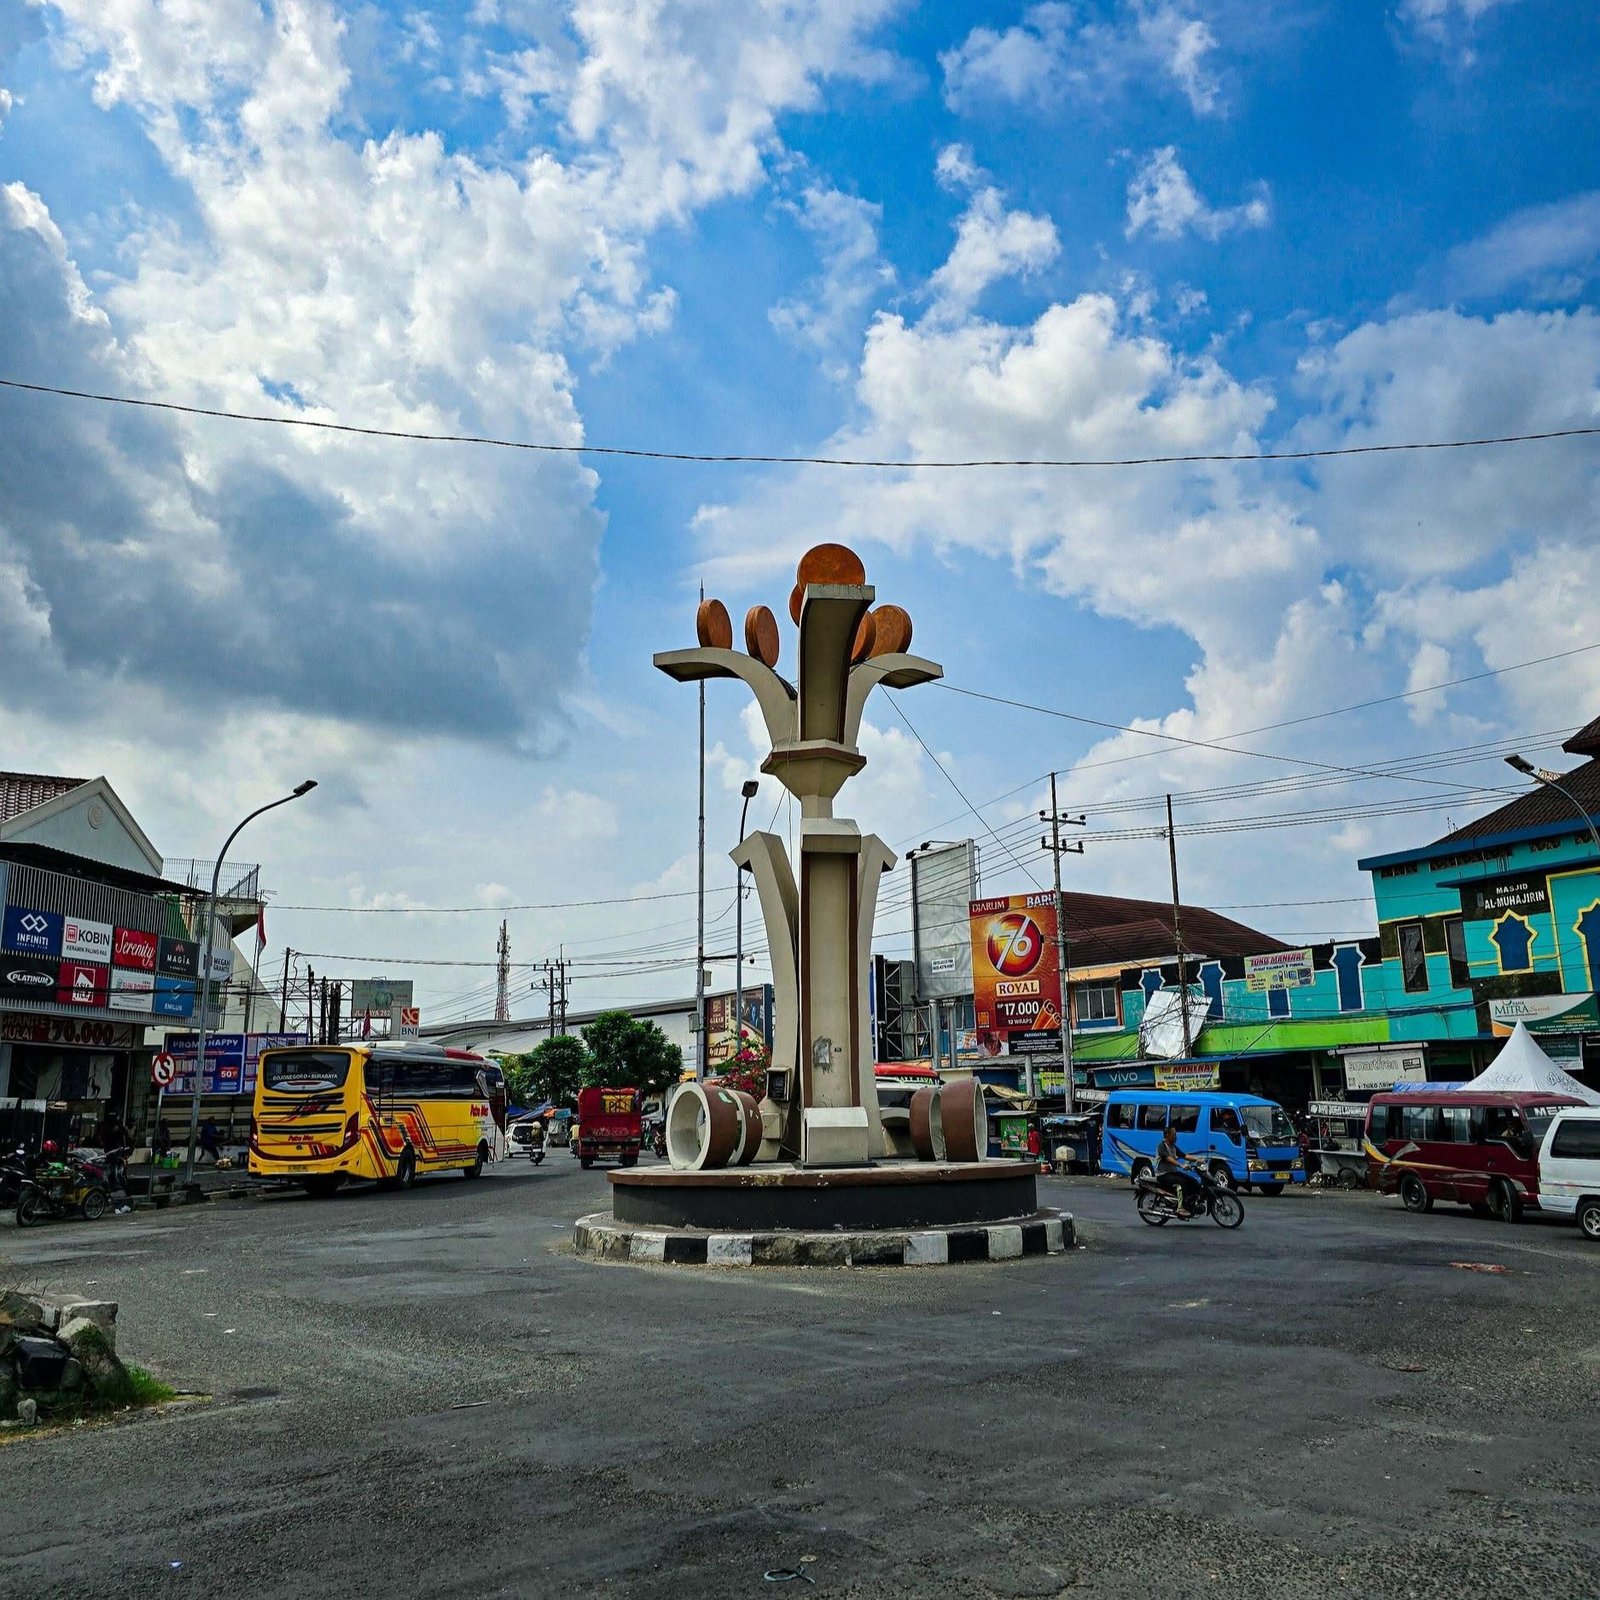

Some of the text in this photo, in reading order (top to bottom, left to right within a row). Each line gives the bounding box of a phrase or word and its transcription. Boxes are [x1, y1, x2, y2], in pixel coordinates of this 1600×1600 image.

[1496, 883, 1528, 894] MASJID
[971, 900, 1005, 912] DJARUM
[17, 932, 49, 946] INFINITI
[79, 929, 110, 946] KOBIN
[996, 916, 1033, 970] 76
[115, 930, 156, 967] Serenity
[12, 973, 49, 985] PLATINUM
[999, 982, 1038, 995] ROYAL
[1004, 1001, 1040, 1016] 17.000
[401, 1027, 418, 1036] BNI
[173, 1039, 239, 1049] PROM HAPPY
[1348, 1058, 1399, 1072] smartfren
